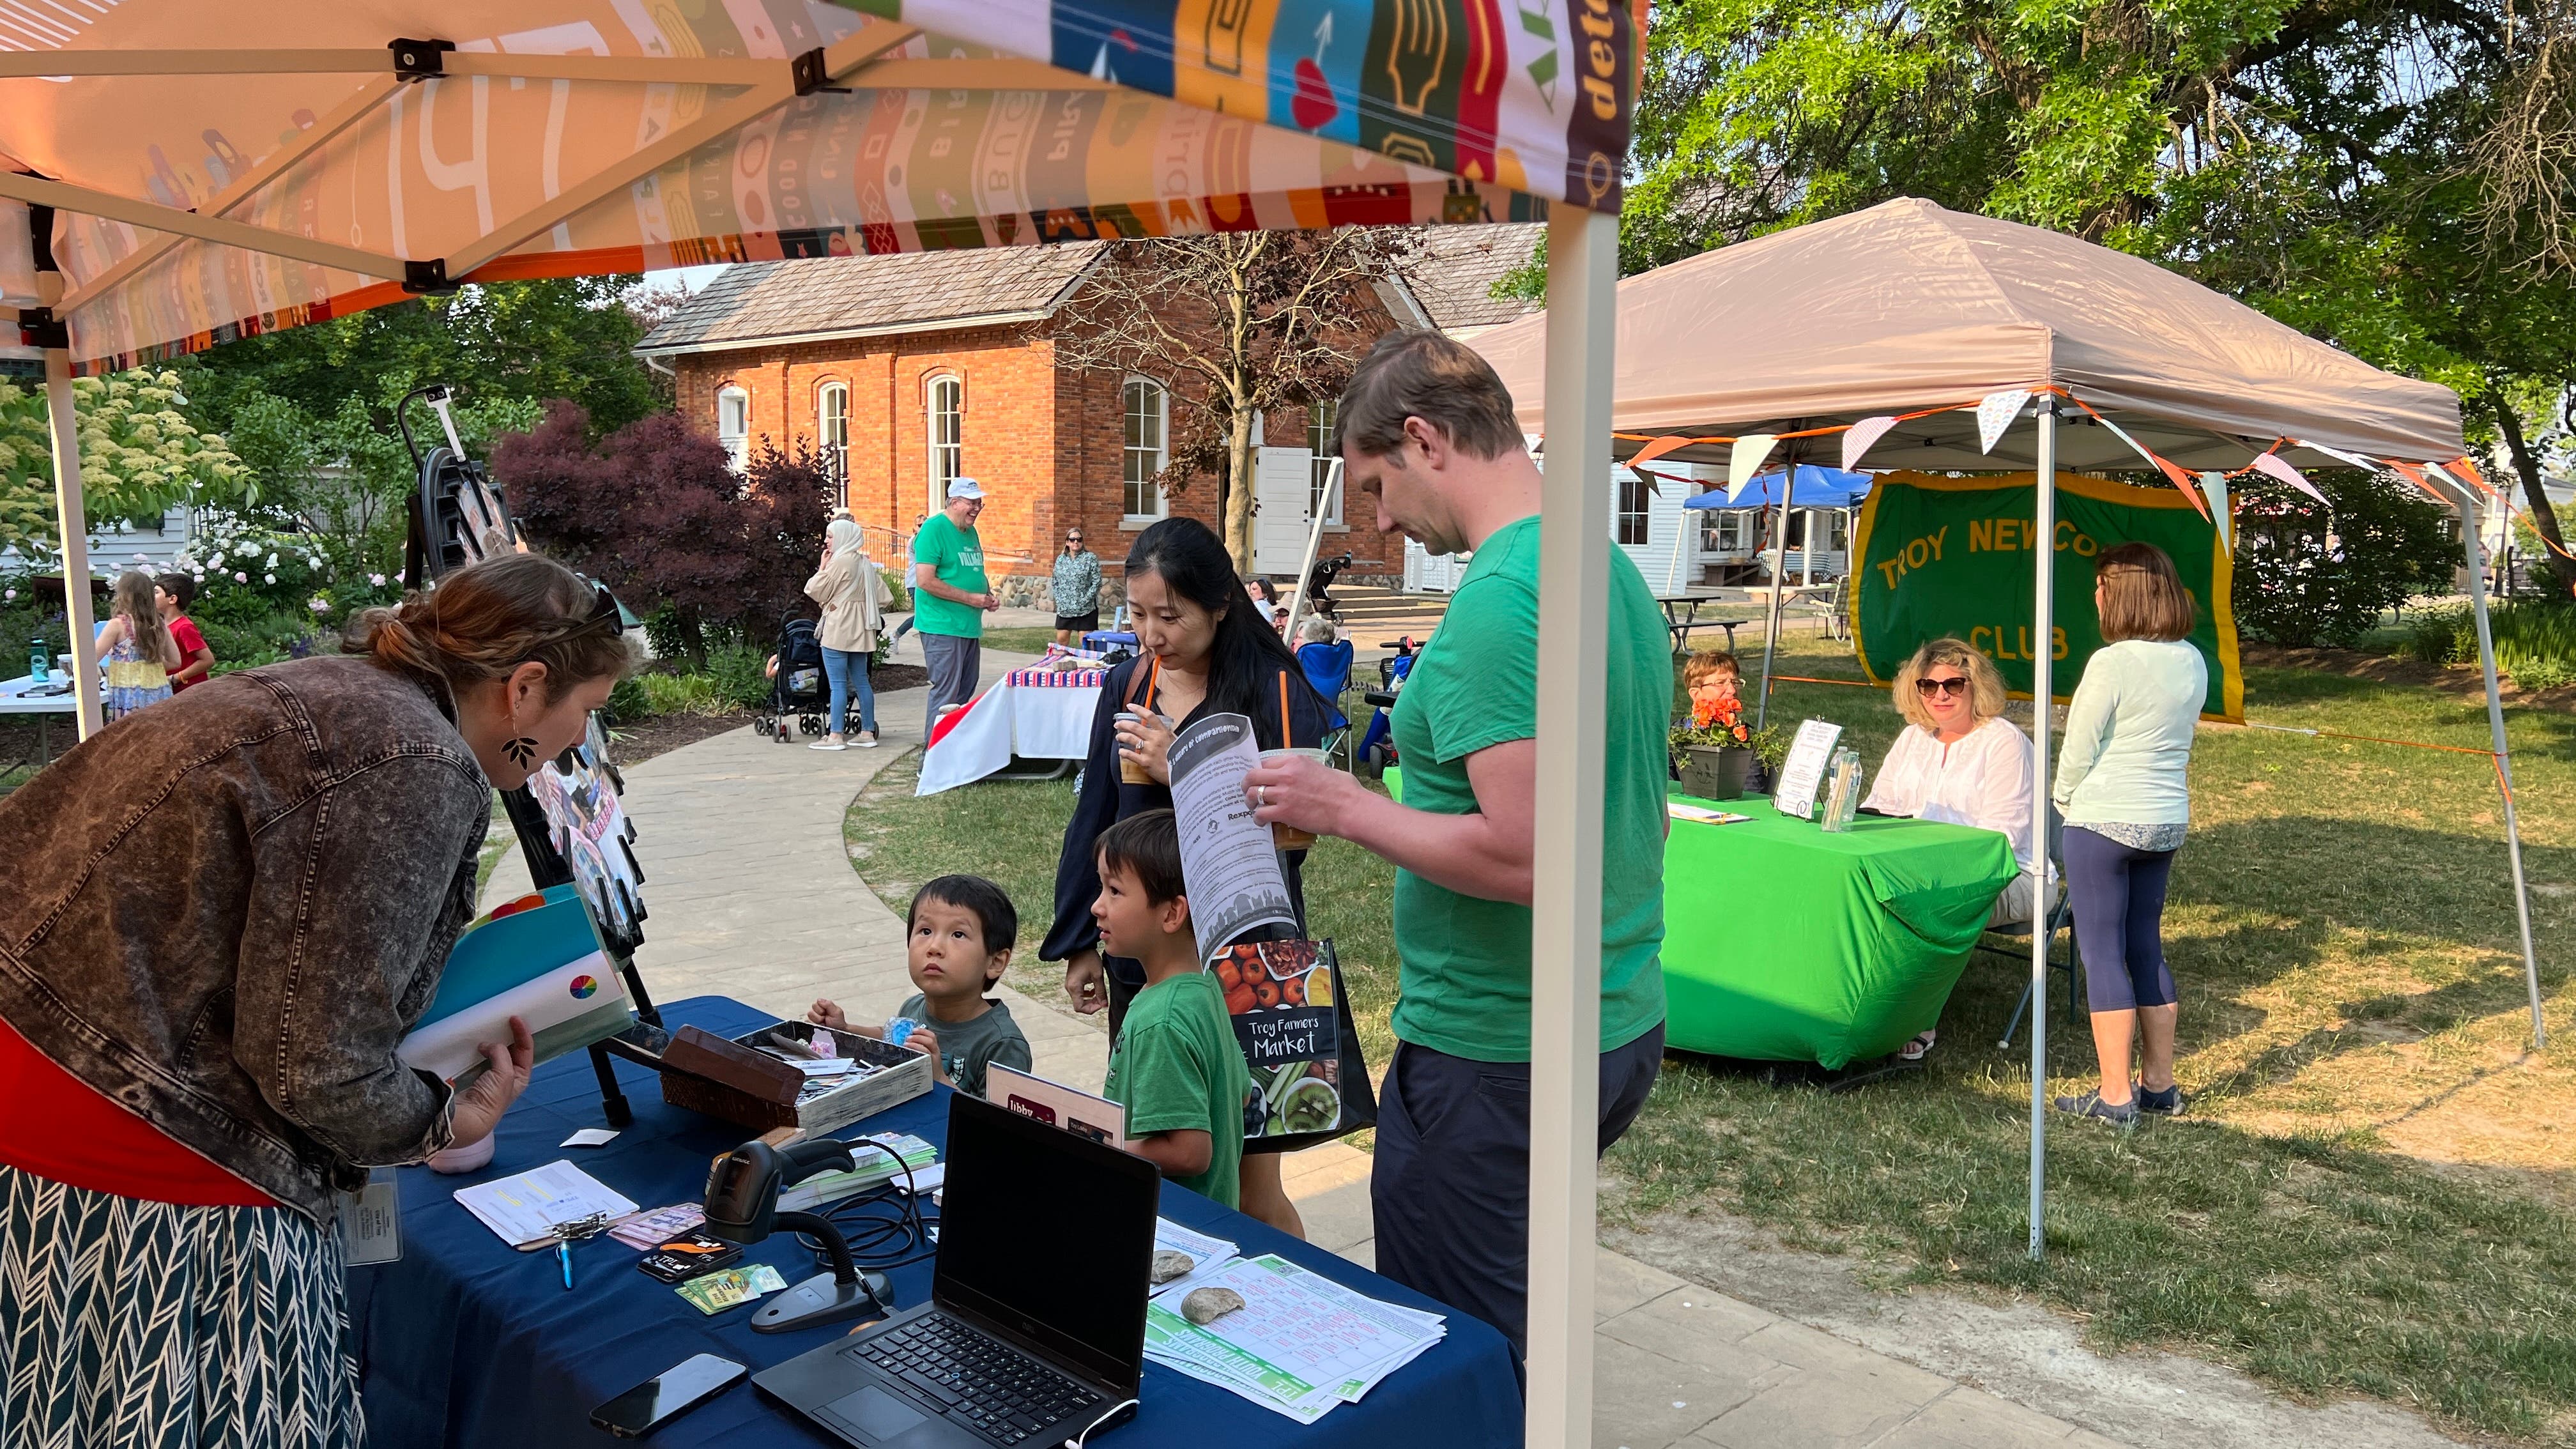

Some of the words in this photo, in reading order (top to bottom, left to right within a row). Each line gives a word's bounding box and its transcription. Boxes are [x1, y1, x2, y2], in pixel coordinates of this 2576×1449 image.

[1877, 526, 1947, 590] TROY
[1970, 626, 2069, 661] CLUB
[1227, 810, 1255, 820] Rexpo
[1248, 1022, 1276, 1038] Troy
[1277, 1018, 1319, 1032] Farmers
[1254, 1031, 1315, 1059] Market
[659, 1254, 678, 1266] TPL
[1174, 1328, 1232, 1361] PROGRAMS
[1229, 1353, 1268, 1380] YOUTH
[1271, 1380, 1299, 1400] TPL
